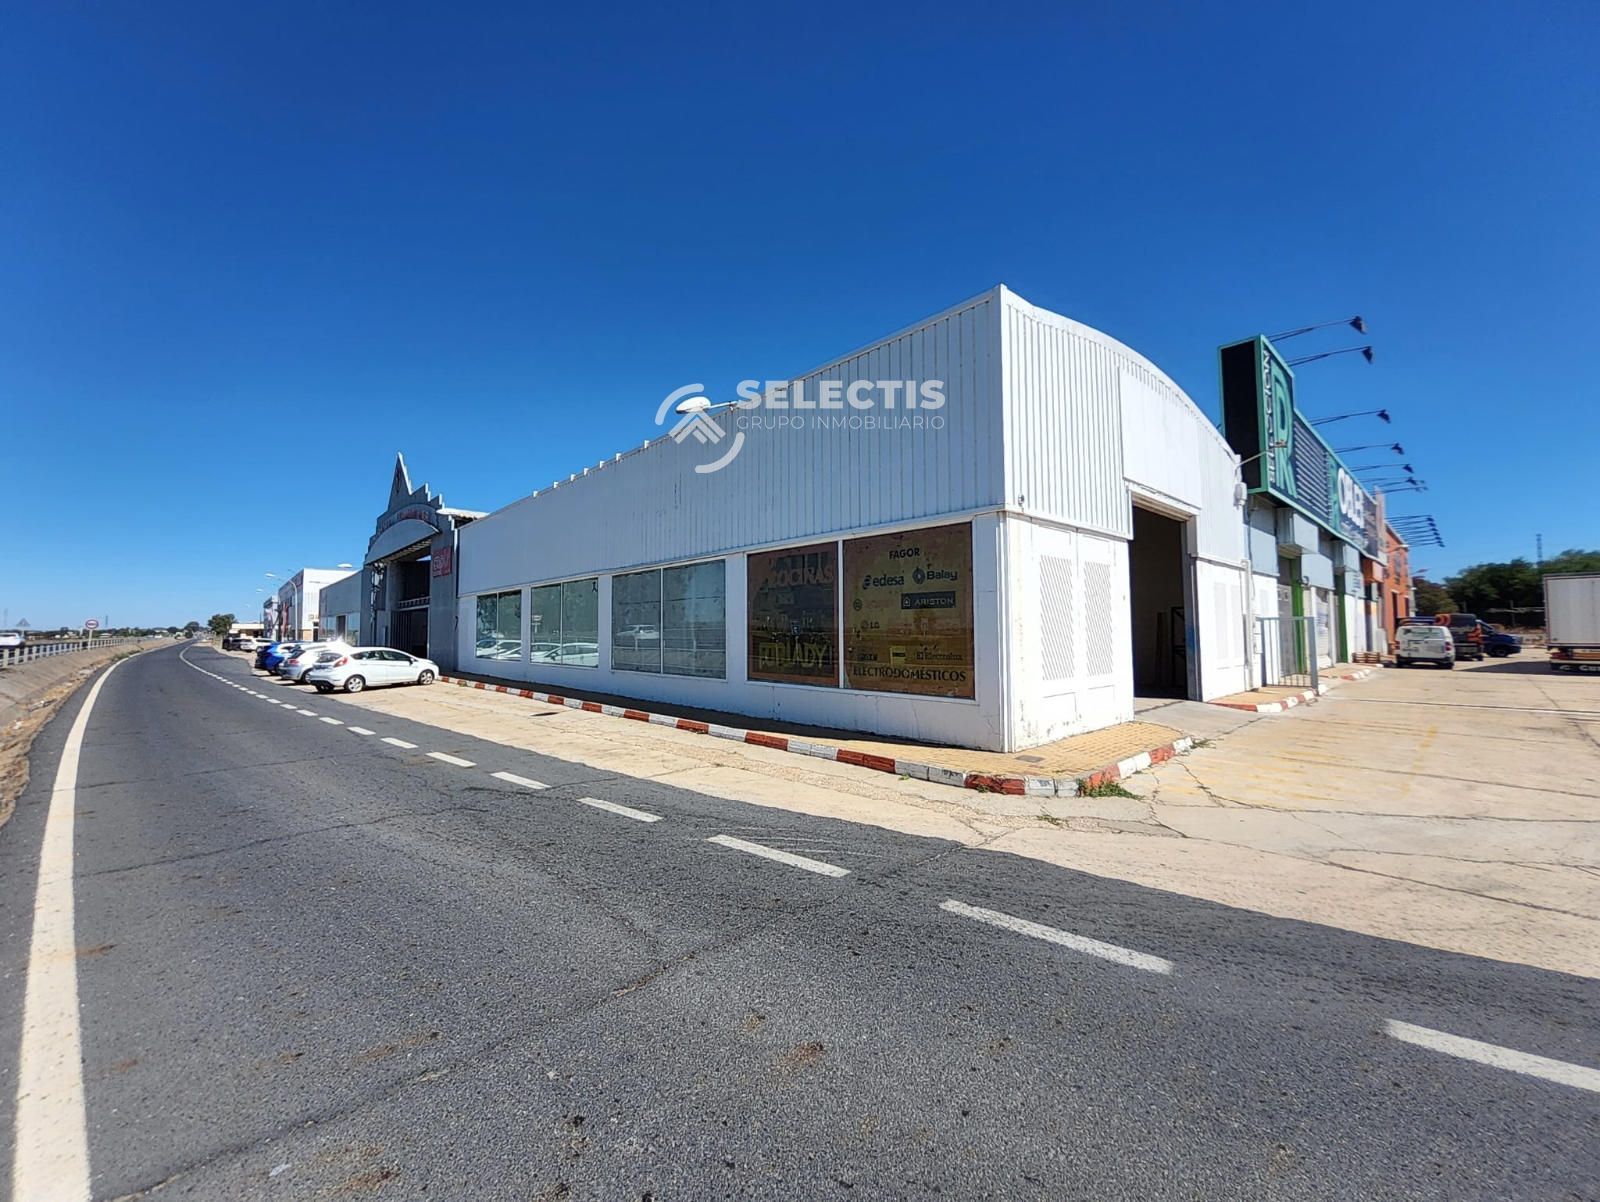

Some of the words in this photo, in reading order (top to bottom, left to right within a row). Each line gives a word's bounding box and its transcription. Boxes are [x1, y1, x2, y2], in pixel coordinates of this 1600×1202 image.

[889, 547, 920, 560] FAGOR
[872, 573, 905, 587] edesa
[926, 569, 958, 582] Balay
[914, 597, 954, 607] ARISTON
[852, 666, 967, 682] ELECTRODOMÉSTICOS
